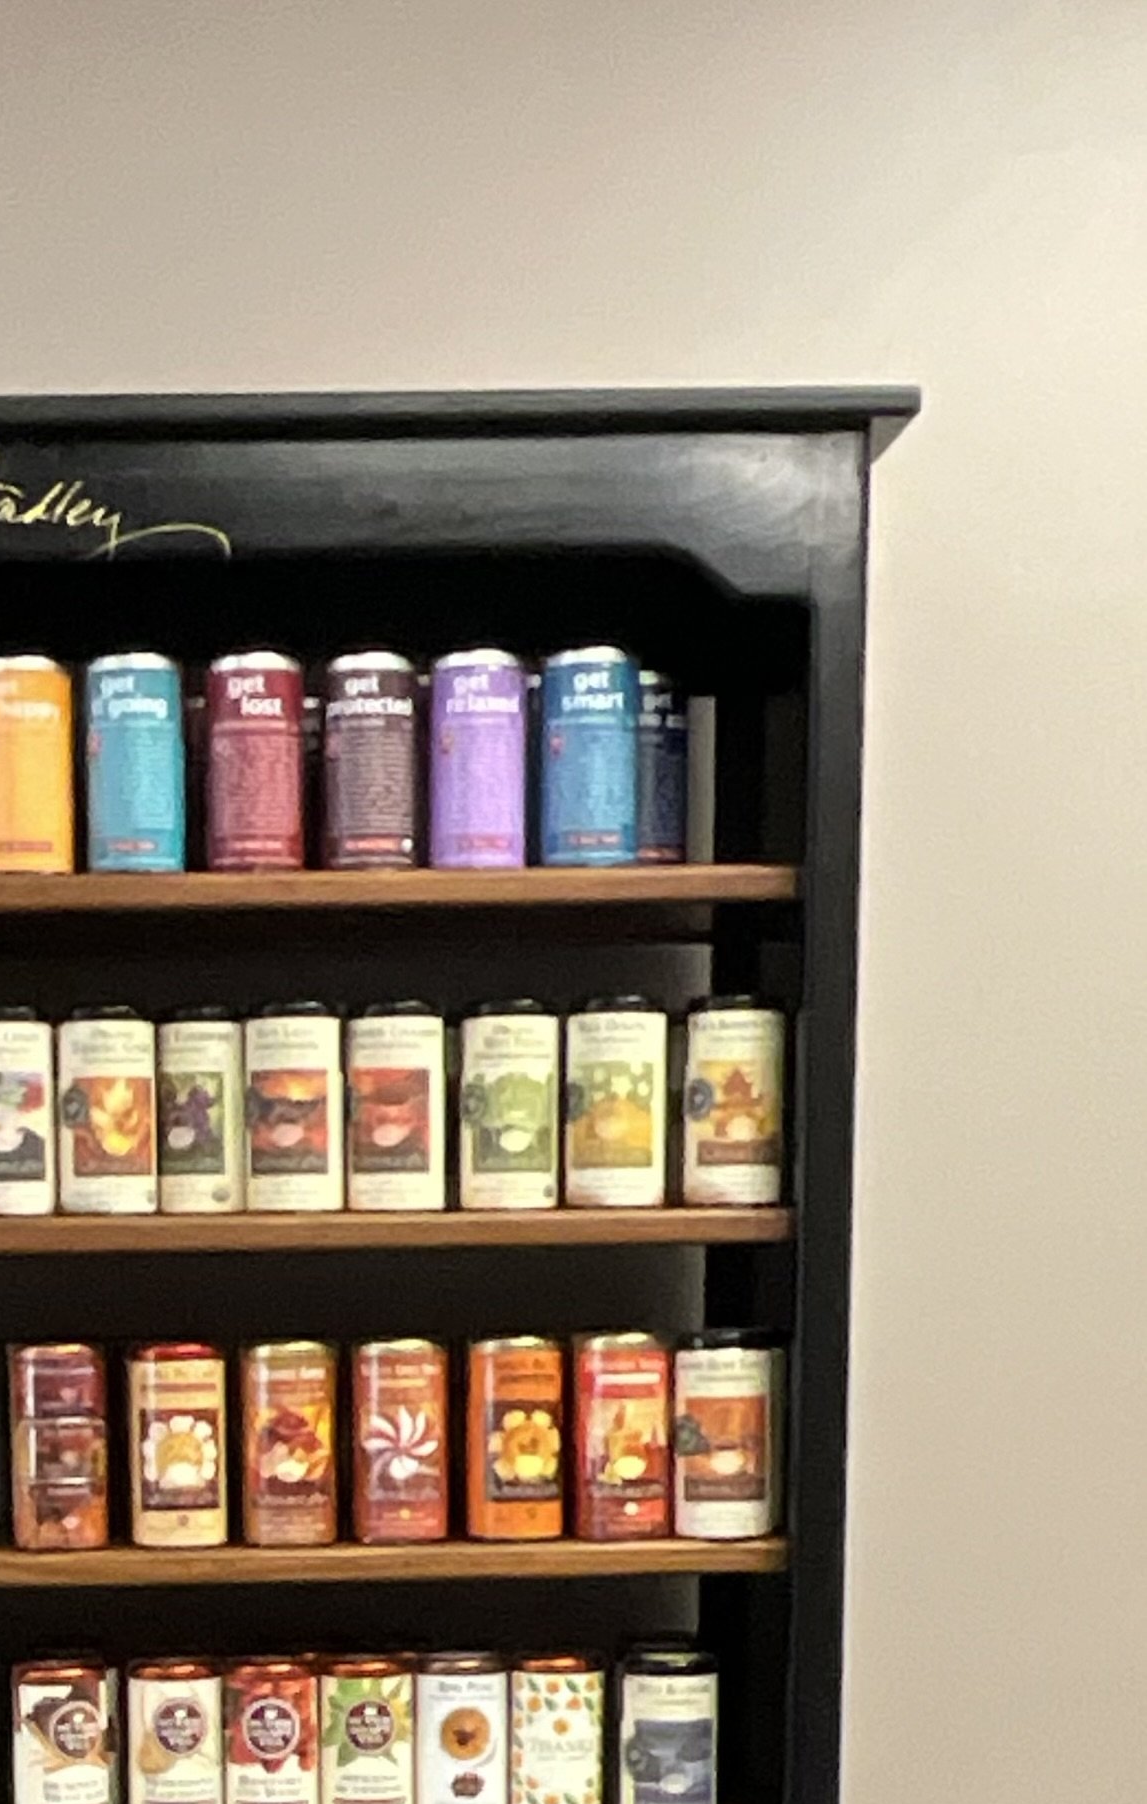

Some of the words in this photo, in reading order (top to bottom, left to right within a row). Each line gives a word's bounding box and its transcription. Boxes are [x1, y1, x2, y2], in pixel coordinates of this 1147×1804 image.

[101, 676, 135, 699] get
[227, 674, 265, 699] get
[345, 673, 380, 696] get
[453, 674, 490, 696] get
[574, 671, 610, 692] get
[108, 694, 168, 720] going
[240, 693, 283, 716] lost
[562, 691, 624, 711] smart
